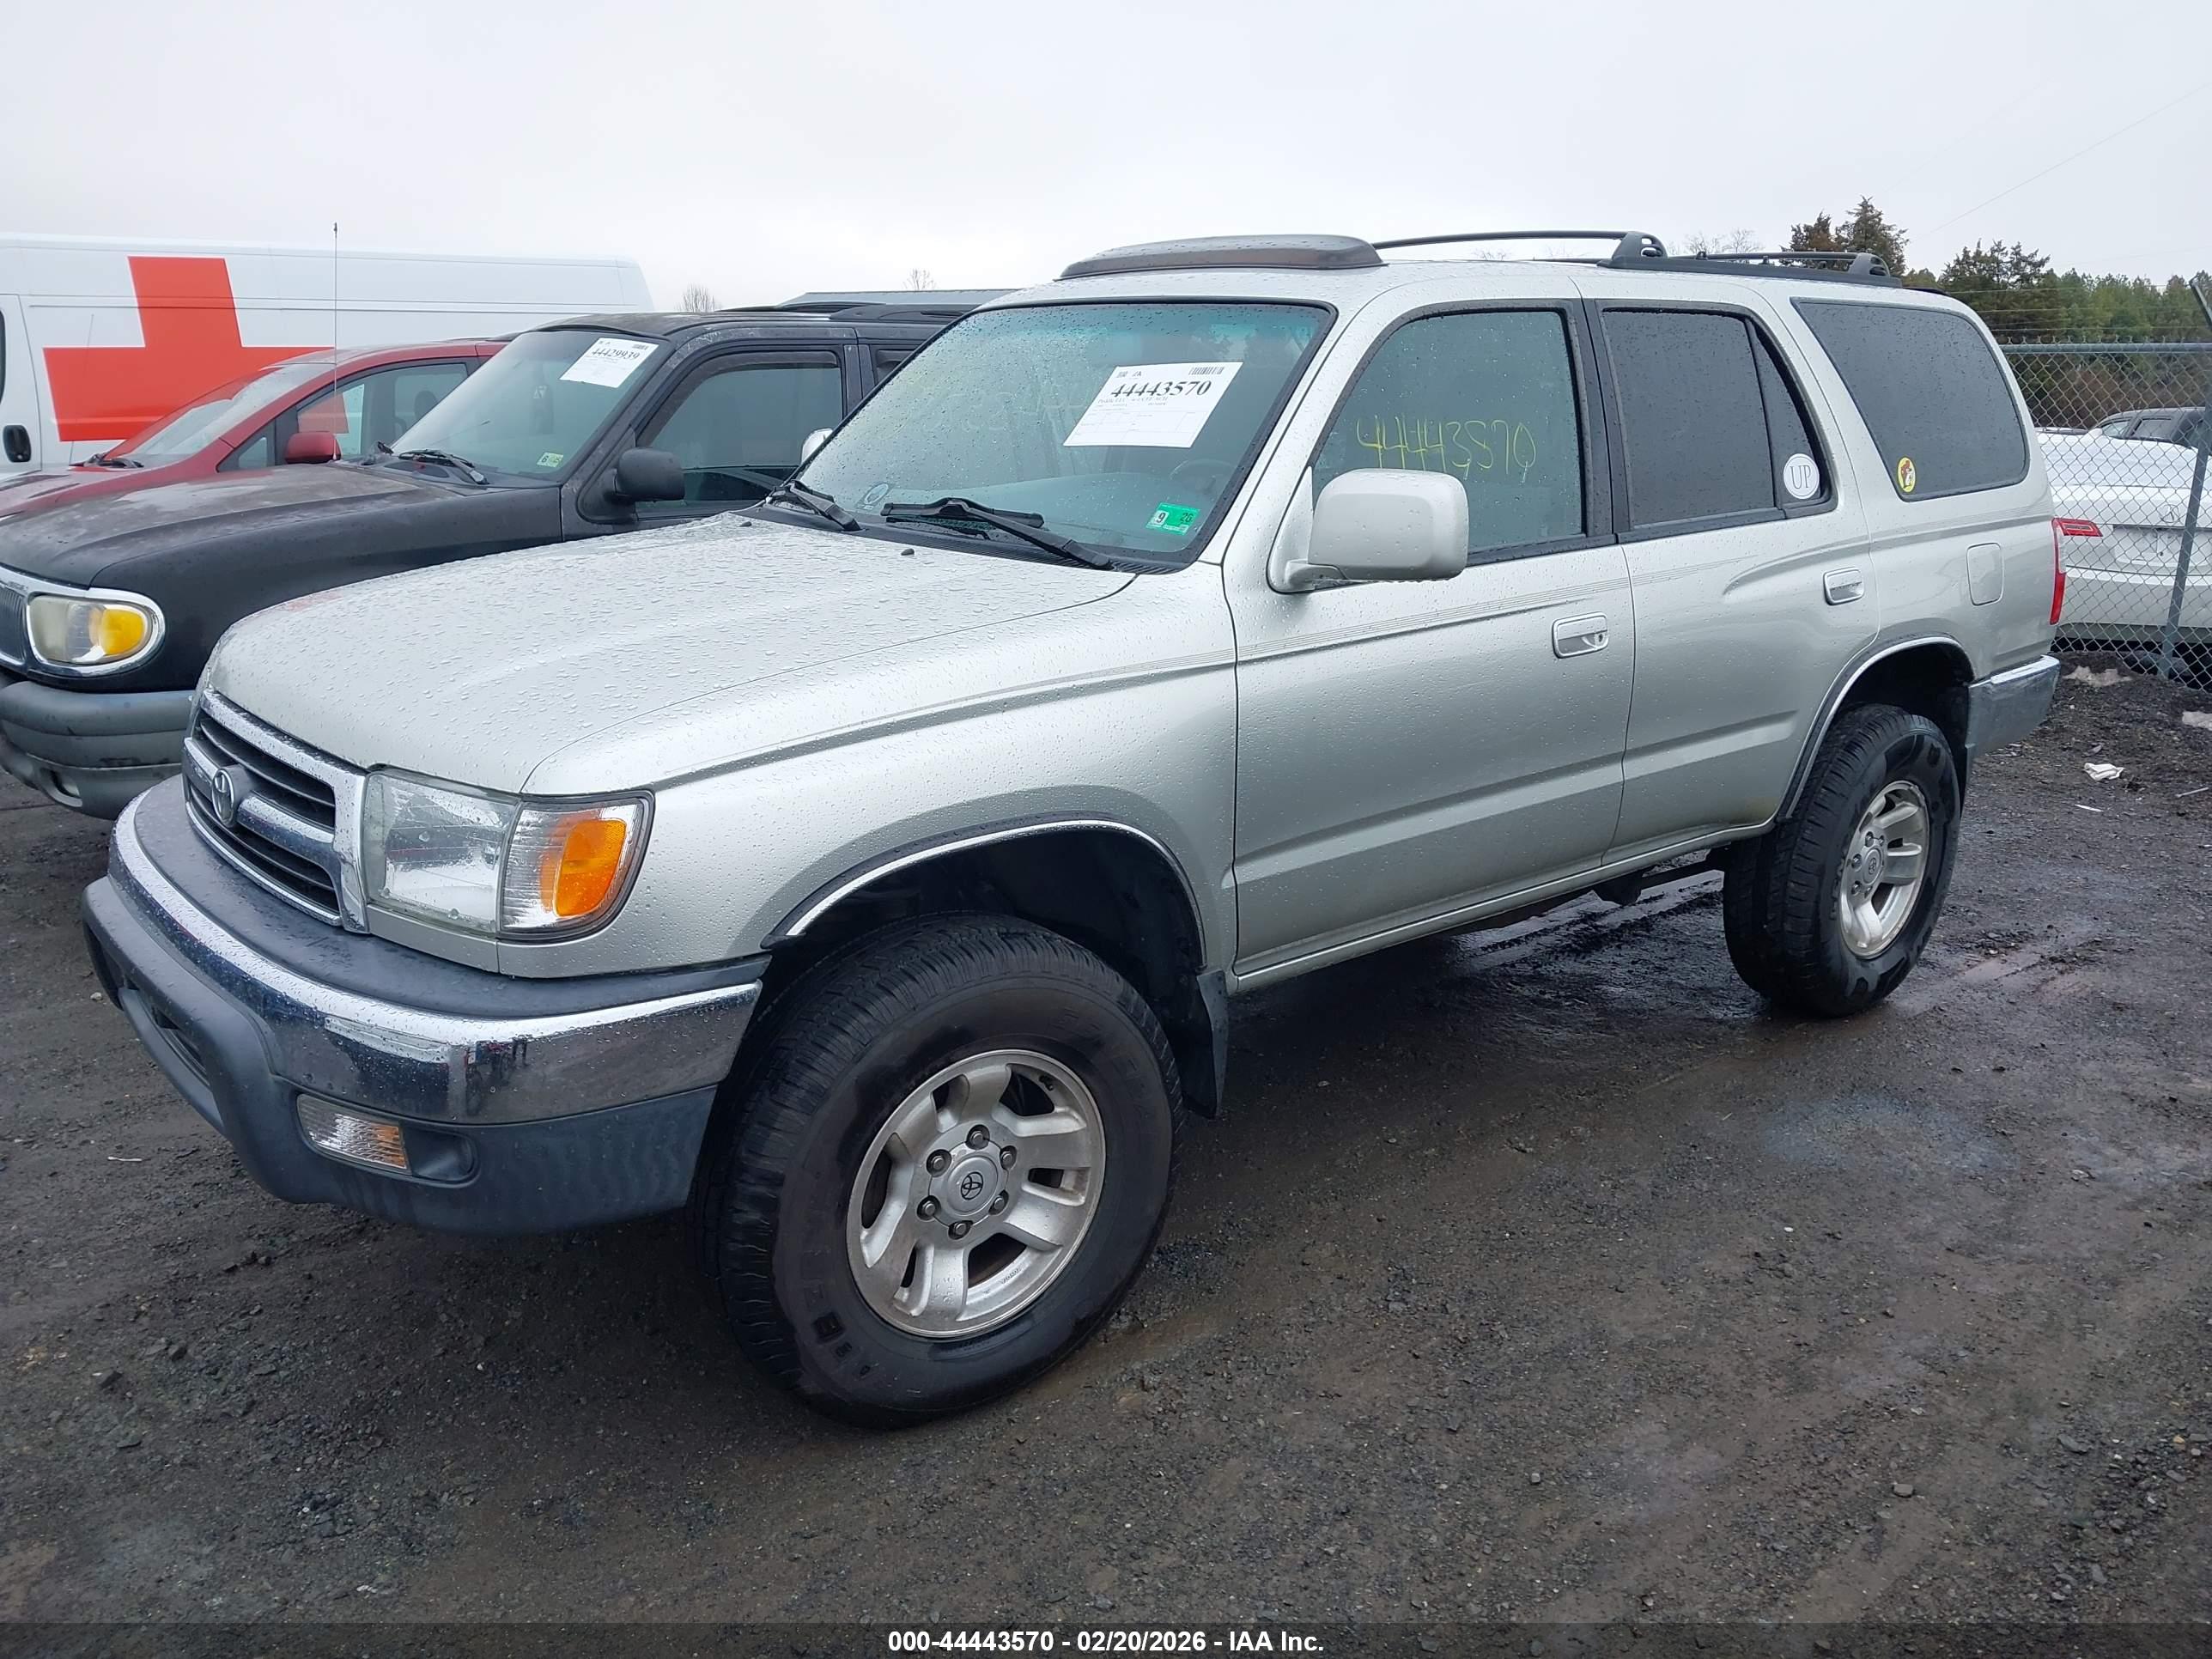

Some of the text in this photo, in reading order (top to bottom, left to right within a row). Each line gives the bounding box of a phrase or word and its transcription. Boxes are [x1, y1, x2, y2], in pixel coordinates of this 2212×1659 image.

[1110, 380, 1212, 398] 44443570
[1356, 415, 1537, 481] 44443570
[1790, 465, 1812, 489] UP
[1156, 512, 1166, 523] 9
